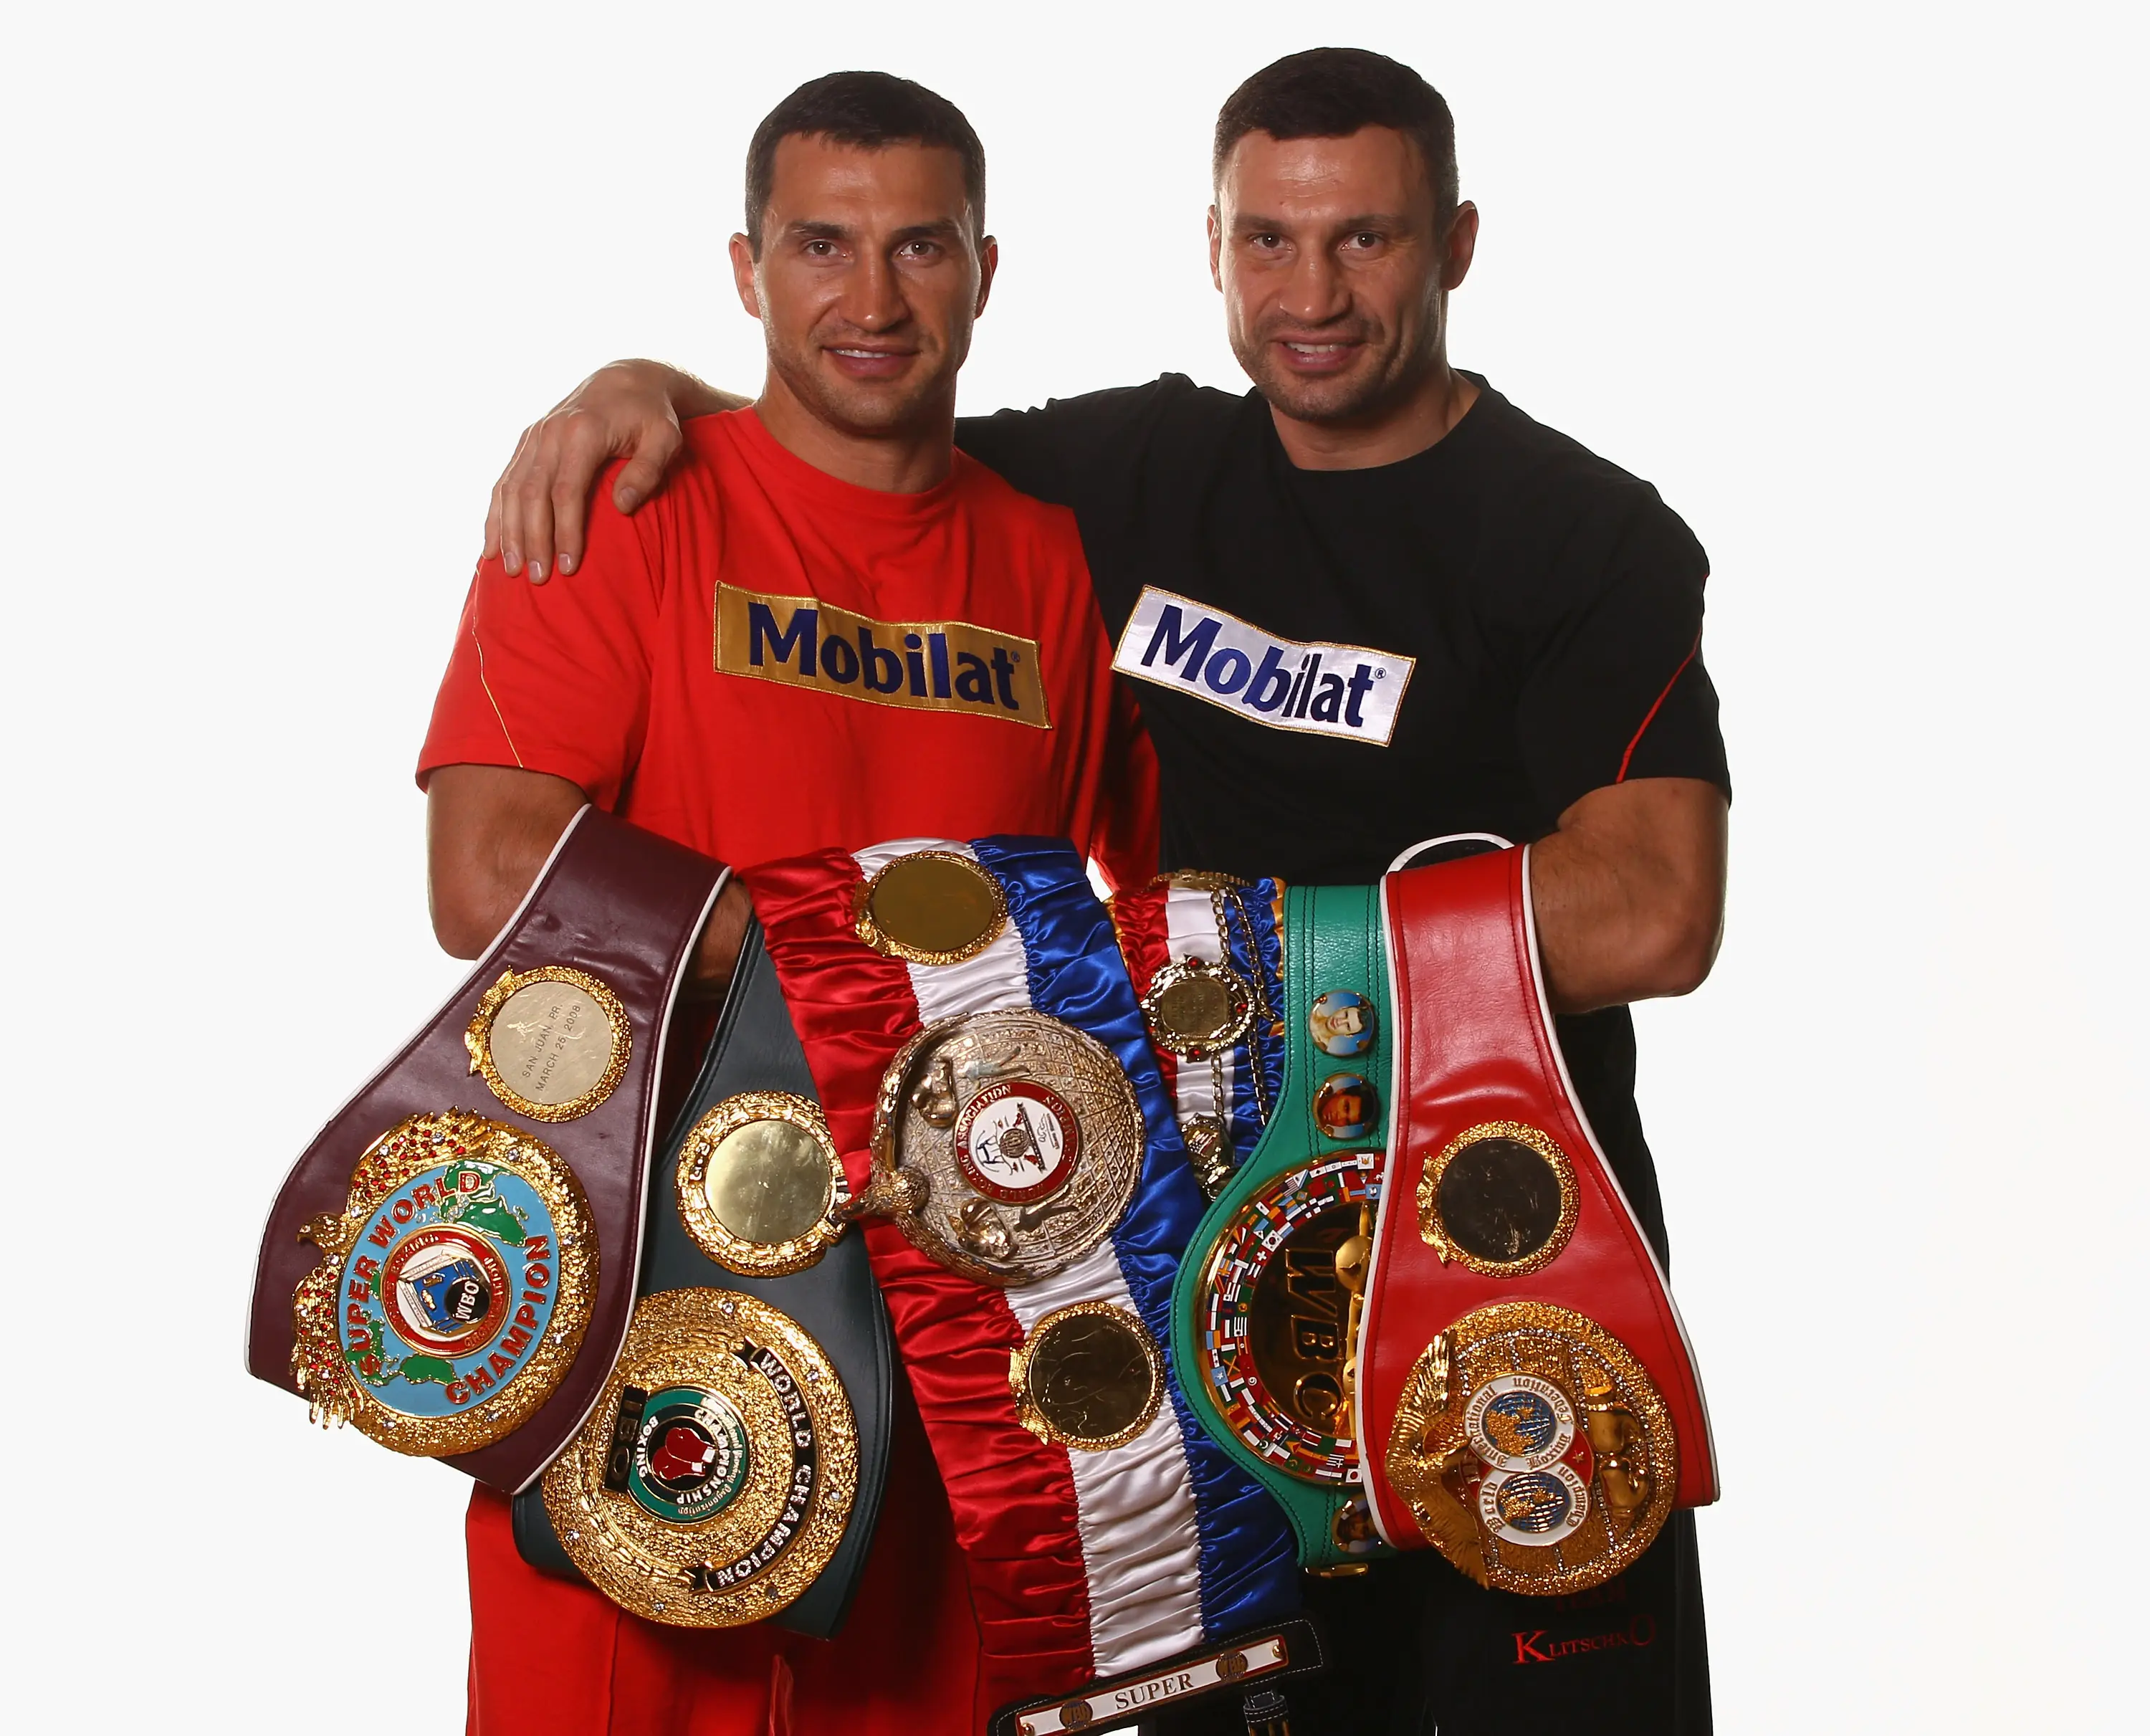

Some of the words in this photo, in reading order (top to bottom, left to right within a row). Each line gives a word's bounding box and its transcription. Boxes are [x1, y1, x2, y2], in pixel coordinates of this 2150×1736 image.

[522, 1056, 538, 1077] SAN
[535, 1053, 559, 1091] MARCH
[564, 1005, 580, 1031] 2008
[347, 1254, 383, 1376] SUPER
[368, 1171, 481, 1248] WORLD
[452, 1281, 479, 1321] WBO
[444, 1234, 550, 1405] CHAMPION
[1285, 1247, 1343, 1421] WBC
[611, 1400, 642, 1479] IBO
[760, 1353, 812, 1449] WORLD
[636, 1416, 659, 1478] BOXING
[677, 1408, 730, 1504] CHAMPIONSHIP
[717, 1464, 811, 1588] CHAMPION
[1114, 1672, 1195, 1711] SUPER
